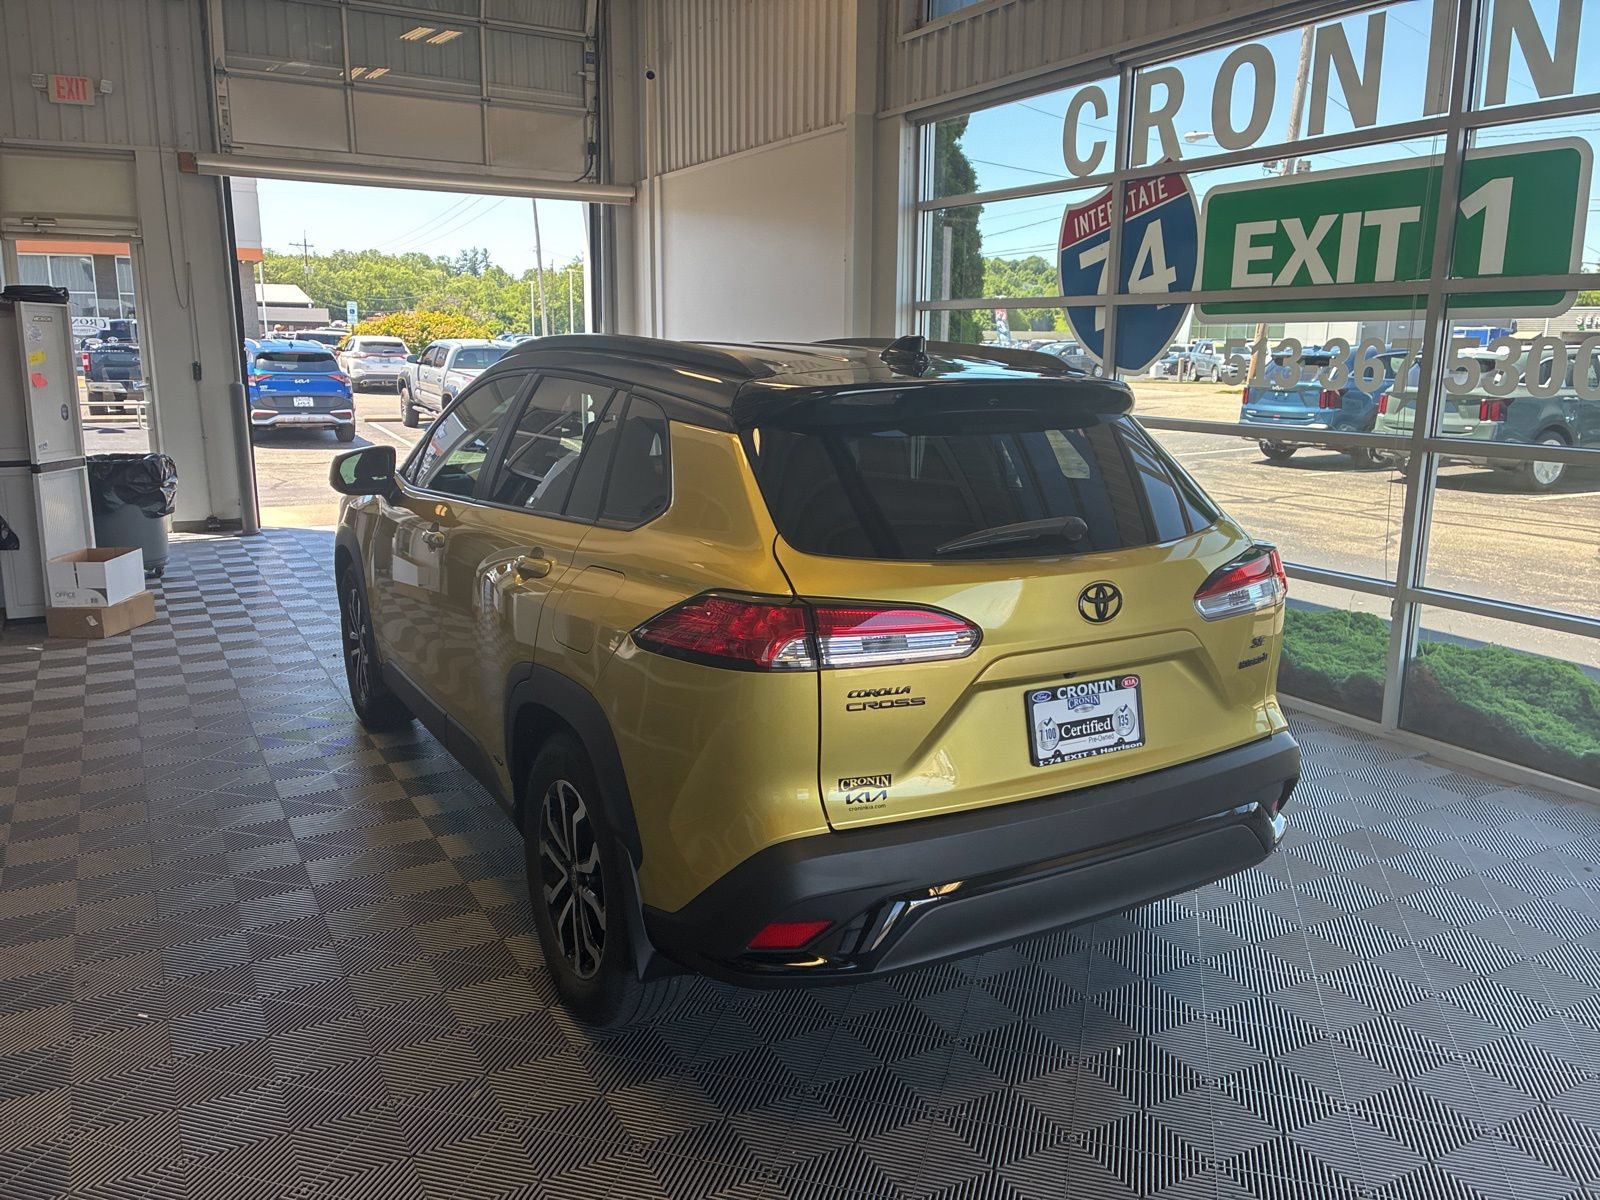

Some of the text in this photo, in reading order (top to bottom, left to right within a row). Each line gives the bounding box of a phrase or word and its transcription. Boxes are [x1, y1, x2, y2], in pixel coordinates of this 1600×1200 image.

[55, 76, 88, 100] EXIT
[1062, 0, 1583, 178] CRONIN
[1074, 176, 1169, 239] INTETATE
[1230, 177, 1515, 289] EXIT 1
[1078, 218, 1178, 330] 74
[1221, 336, 1600, 401] 513-3675300
[847, 686, 912, 699] COROLLA
[1057, 680, 1116, 699] CRONIN
[1124, 678, 1136, 687] KIA
[846, 697, 926, 712] CROSS
[1068, 695, 1100, 710] CRONIN
[1061, 718, 1111, 738] Certified
[1088, 733, 1115, 744] Pre-Owned
[1038, 756, 1062, 767] I-74
[1064, 751, 1089, 761] EXIT
[1100, 742, 1143, 755] Harrison
[840, 774, 891, 792] CRONIN
[845, 789, 888, 805] KIA
[848, 803, 887, 812] croninkia.com
